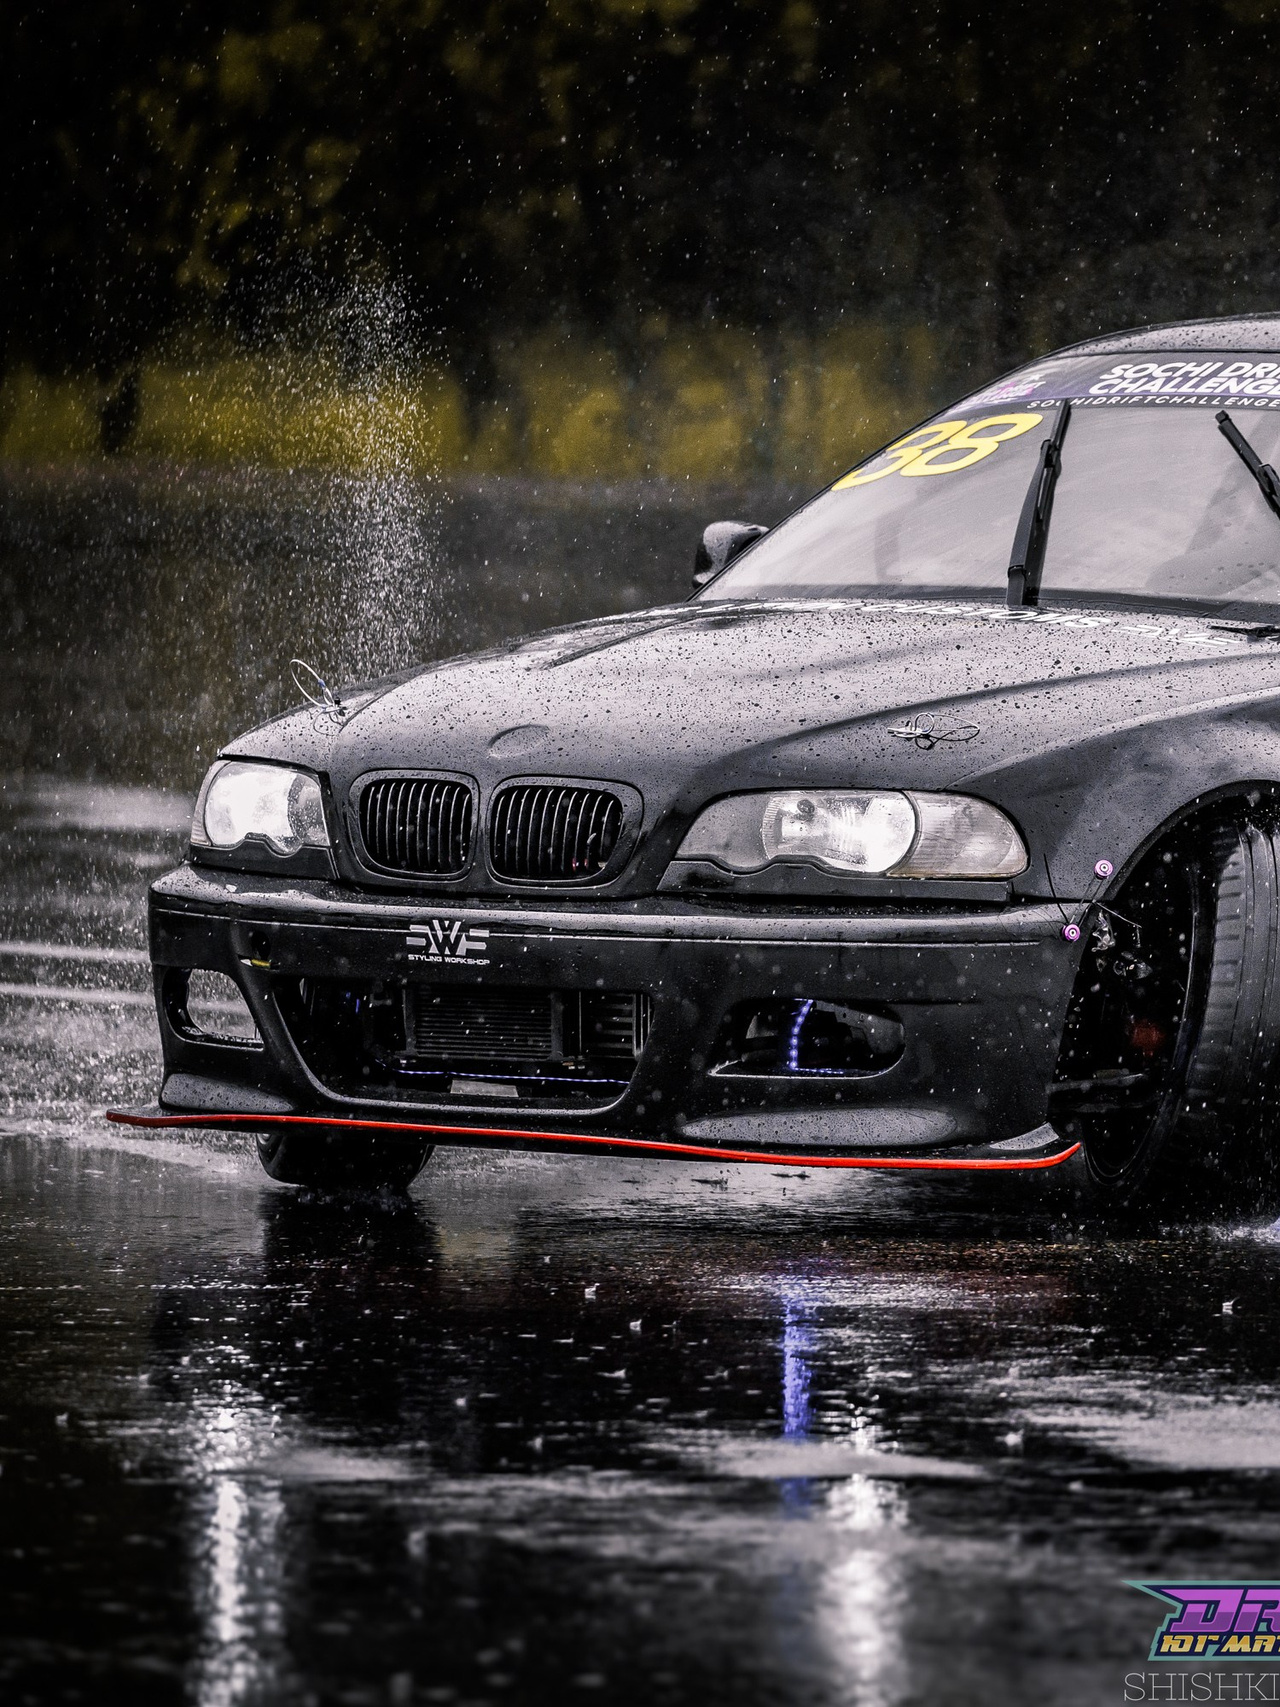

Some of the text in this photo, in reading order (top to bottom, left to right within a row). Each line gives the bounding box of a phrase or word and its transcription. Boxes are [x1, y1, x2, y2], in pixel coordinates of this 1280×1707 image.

[1100, 362, 1222, 381] SOCHI
[860, 603, 1112, 628] CUSTOMS
[408, 954, 490, 966] STYLING WORKSHOP
